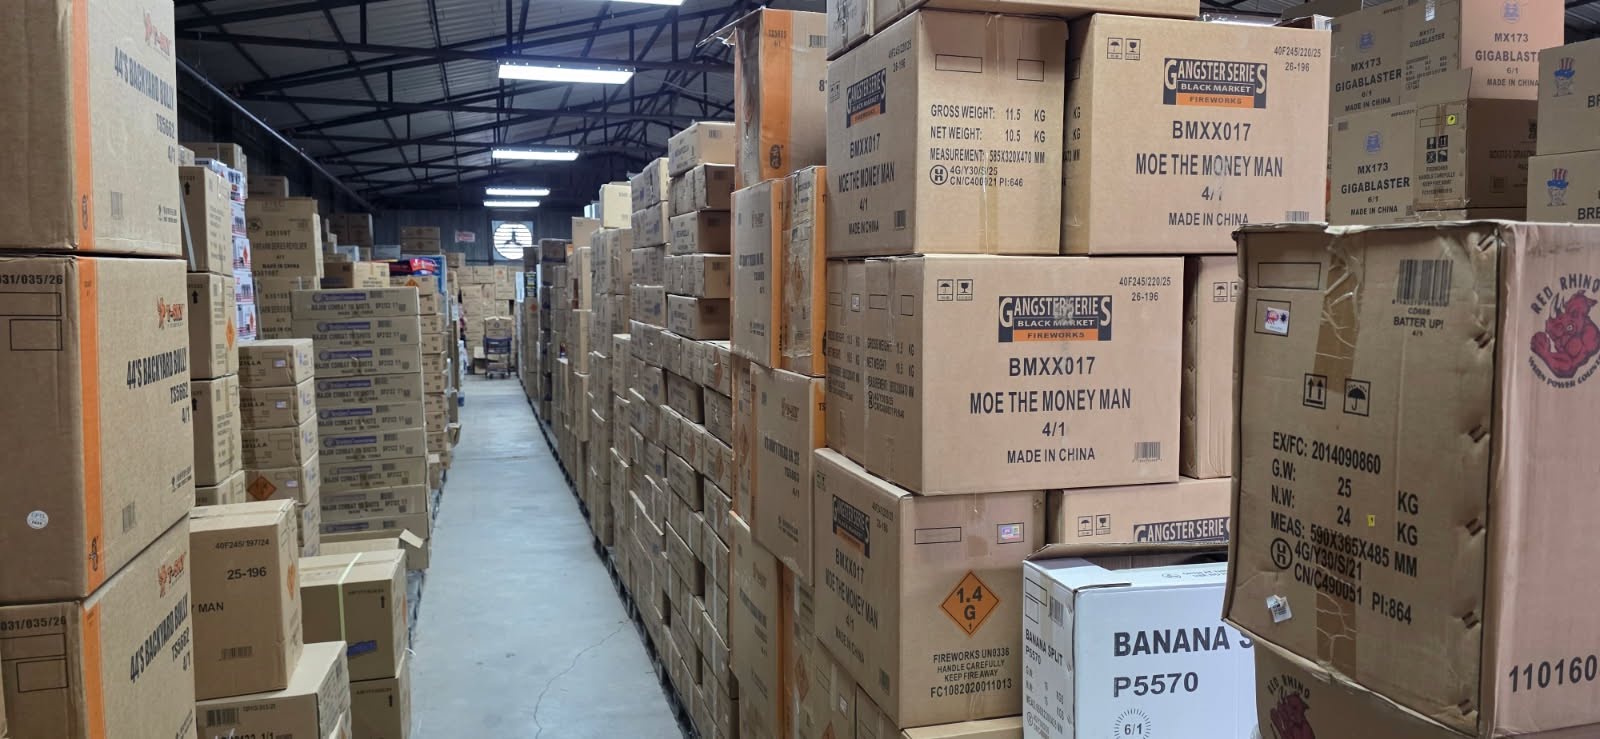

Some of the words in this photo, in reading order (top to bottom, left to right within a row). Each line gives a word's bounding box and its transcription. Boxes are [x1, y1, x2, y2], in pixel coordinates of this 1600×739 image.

[1494, 33, 1529, 42] MX173
[1274, 46, 1322, 58] 40F245/220/25
[1475, 50, 1540, 62] GIGABLAST
[1284, 62, 1310, 72] 26-196
[1351, 57, 1382, 72] MX173
[1164, 59, 1226, 90] GANGSTER
[1227, 64, 1266, 94] SERIES
[1335, 68, 1402, 92] GIGABLASTER
[1486, 78, 1506, 86] MADE
[1518, 79, 1539, 87] CHINA
[1180, 83, 1212, 92] BLACK
[1212, 84, 1251, 94] MARKET
[1189, 96, 1242, 104] FIREWORKS
[1345, 102, 1361, 112] MADE
[1372, 97, 1391, 106] CHINA
[931, 104, 960, 118] GROSS
[962, 106, 995, 120] WEIGHT:
[1006, 108, 1021, 120] 11.5
[1034, 110, 1046, 122] KG
[930, 126, 946, 140] NET
[948, 127, 982, 140] WEIGHT:
[1006, 129, 1021, 142] 10.5
[1034, 131, 1046, 143] KG
[1172, 120, 1251, 141] BMXX017
[850, 133, 880, 158] BMXX017
[930, 148, 985, 162] MEASUREMENT:
[990, 150, 1032, 164] 595X320X470
[1034, 152, 1046, 164] MM
[1136, 153, 1167, 174] MOE
[1172, 154, 1198, 176] THE
[1202, 154, 1251, 176] MONEY
[1254, 157, 1283, 178] MAN
[1358, 162, 1388, 174] MX173
[838, 172, 849, 192] MOE
[850, 170, 860, 190] THE
[860, 165, 880, 188] MONEY
[881, 162, 895, 183] MAN
[1000, 178, 1024, 187] PI:646
[1341, 176, 1410, 194] GIGABLASTER
[1201, 186, 1222, 200] 4/1
[860, 197, 868, 212] 4/1
[1378, 205, 1398, 214] CHINA
[849, 222, 860, 235] MADE
[861, 221, 866, 234] IN
[866, 220, 879, 233] CHINA
[1168, 212, 1200, 226] MADE
[1203, 213, 1213, 225] IN
[1216, 213, 1248, 226] CHINA
[1119, 276, 1171, 287] 40F245/220/25
[1132, 292, 1158, 302] 26-196
[1530, 286, 1554, 314] RED
[1560, 273, 1600, 293] RHINO
[1000, 297, 1066, 328] GANGSTER
[1067, 296, 1110, 327] SERIES
[1052, 318, 1094, 327] MARKET
[1394, 316, 1426, 329] BATTER
[1429, 319, 1444, 330] UP!
[1027, 332, 1085, 340] FIREWORKS
[127, 359, 142, 389] 44'S
[143, 350, 174, 386] BACKYARD
[174, 347, 188, 374] BULLY
[1008, 356, 1096, 376] BMXX017
[1546, 378, 1576, 388] POWER
[170, 383, 188, 404] TS5662
[970, 392, 1004, 414] MOE
[1008, 391, 1038, 412] THE
[1042, 389, 1096, 412] MONEY
[1100, 388, 1131, 409] MAN
[1042, 422, 1066, 437] 4/1
[1007, 448, 1041, 464] MADE
[1044, 449, 1056, 462] IN
[1058, 448, 1095, 462] CHINA
[1272, 432, 1308, 457] EX/FC:
[1312, 440, 1381, 475] 2014090860
[1272, 458, 1296, 482] G.W:
[1338, 476, 1352, 498] 25
[1398, 490, 1418, 516] KG
[1271, 484, 1295, 509] N.W:
[1336, 505, 1351, 527] 24
[1396, 521, 1418, 546] KG
[1134, 522, 1195, 542] GANGSTER
[1196, 518, 1231, 538] SERIE
[1270, 511, 1305, 540] MEAS:
[1310, 524, 1390, 568] 590X365X485
[1394, 552, 1418, 578] MM
[836, 548, 864, 584] BMXX017
[1294, 540, 1362, 580] 4G/Y30/S/21
[227, 566, 267, 580] 25-196
[826, 568, 836, 592] MOE
[836, 576, 845, 600] THE
[846, 585, 864, 616] MONEY
[866, 602, 878, 632] MAN
[956, 586, 982, 604] 1.4
[1294, 563, 1362, 604] CN/C490051
[1372, 592, 1412, 626] PI:864
[198, 602, 224, 613] MAN
[964, 605, 976, 620] G
[130, 647, 145, 684] 44'S
[145, 609, 174, 667] BACKYARD
[174, 592, 188, 634] BULLY
[172, 626, 190, 662] TS5662
[1114, 626, 1230, 656] BANANA
[1026, 629, 1046, 652] BANANA
[1048, 645, 1063, 666] SPLIT
[1026, 645, 1042, 665] P5570
[933, 650, 980, 664] FIREWORKS
[938, 664, 965, 674] HANDLE
[966, 660, 1005, 671] CAREFULLY
[1508, 654, 1598, 693] 110160
[944, 673, 962, 682] KEEP
[964, 672, 978, 680] FIRE
[980, 670, 998, 679] AWAY
[930, 678, 1012, 698] FC1082020011013
[1114, 672, 1199, 698] P5570
[1124, 723, 1142, 736] 6/1
